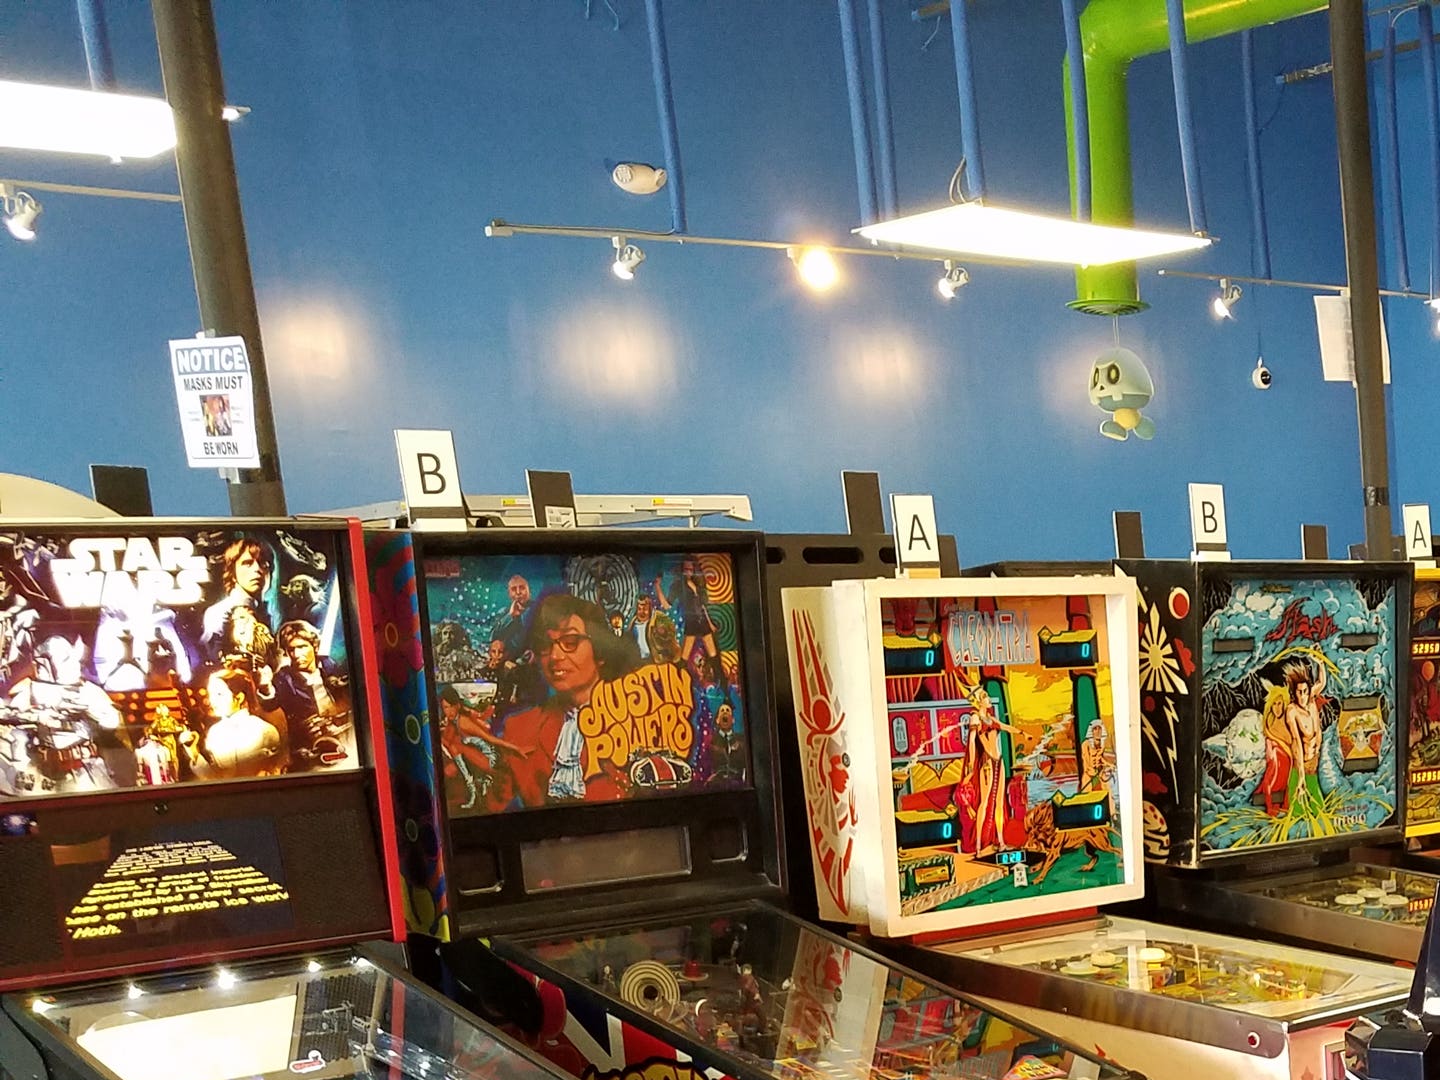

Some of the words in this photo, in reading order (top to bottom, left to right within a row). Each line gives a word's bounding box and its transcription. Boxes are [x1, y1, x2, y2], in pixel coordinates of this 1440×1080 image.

[176, 346, 247, 374] NOTICE
[184, 376, 212, 391] MASKS
[215, 375, 243, 390] MUST
[203, 442, 215, 455] BE
[216, 442, 239, 455] WORN
[417, 452, 446, 495] B
[907, 514, 931, 551] A
[1202, 501, 1218, 534] B
[1412, 520, 1429, 549] A
[50, 536, 209, 571] STAR
[52, 569, 211, 608] WARS
[947, 609, 1037, 668] CLEOPATRA
[1081, 642, 1091, 658] 0
[925, 650, 935, 667] 0
[578, 662, 694, 737] AUSTIN
[584, 702, 693, 782] POWERS
[1094, 803, 1103, 820] 0
[943, 822, 953, 840] 0
